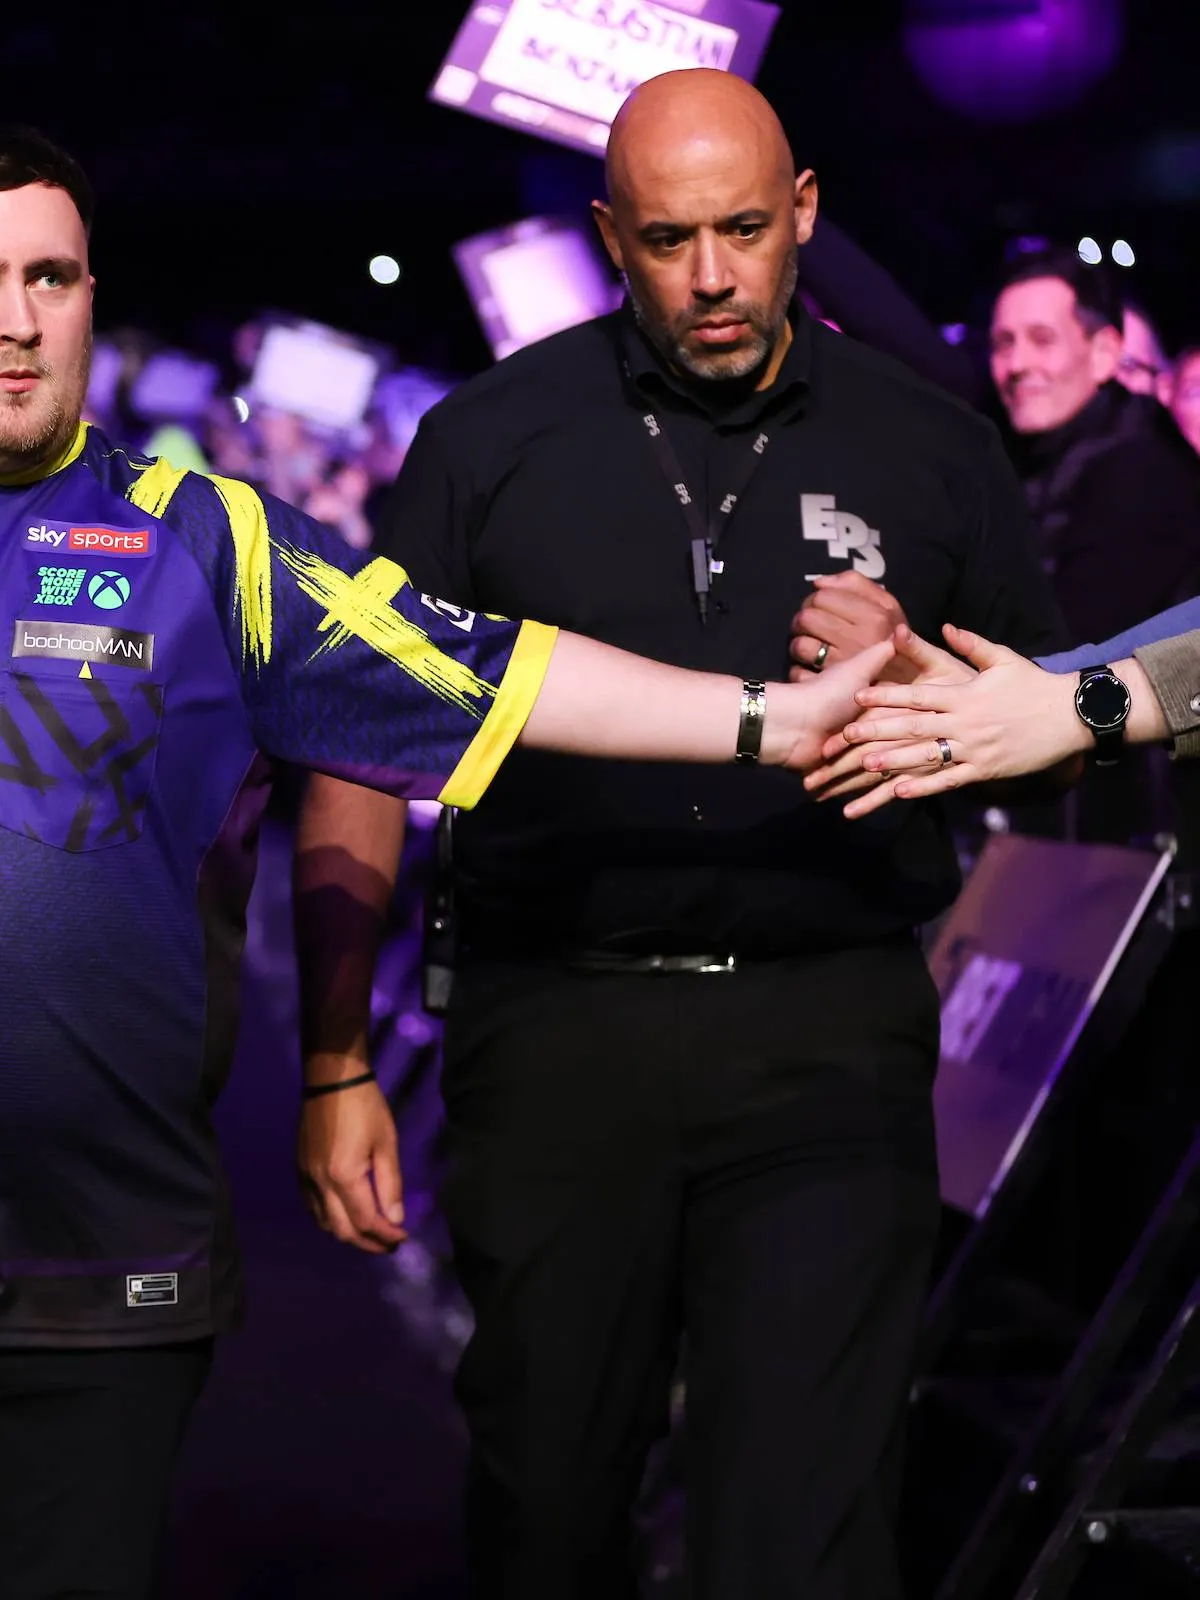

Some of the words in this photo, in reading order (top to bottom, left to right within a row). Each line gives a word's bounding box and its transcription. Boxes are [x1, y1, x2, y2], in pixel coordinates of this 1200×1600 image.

[643, 414, 661, 437] EPS
[674, 483, 692, 505] EPS
[27, 525, 67, 547] sky
[73, 532, 144, 549] sports
[800, 493, 886, 580] EPS
[37, 566, 87, 578] SCORE
[40, 576, 85, 588] MORE
[33, 594, 75, 606] XBOX
[41, 585, 80, 597] WITH
[23, 631, 143, 660] boohooMAN
